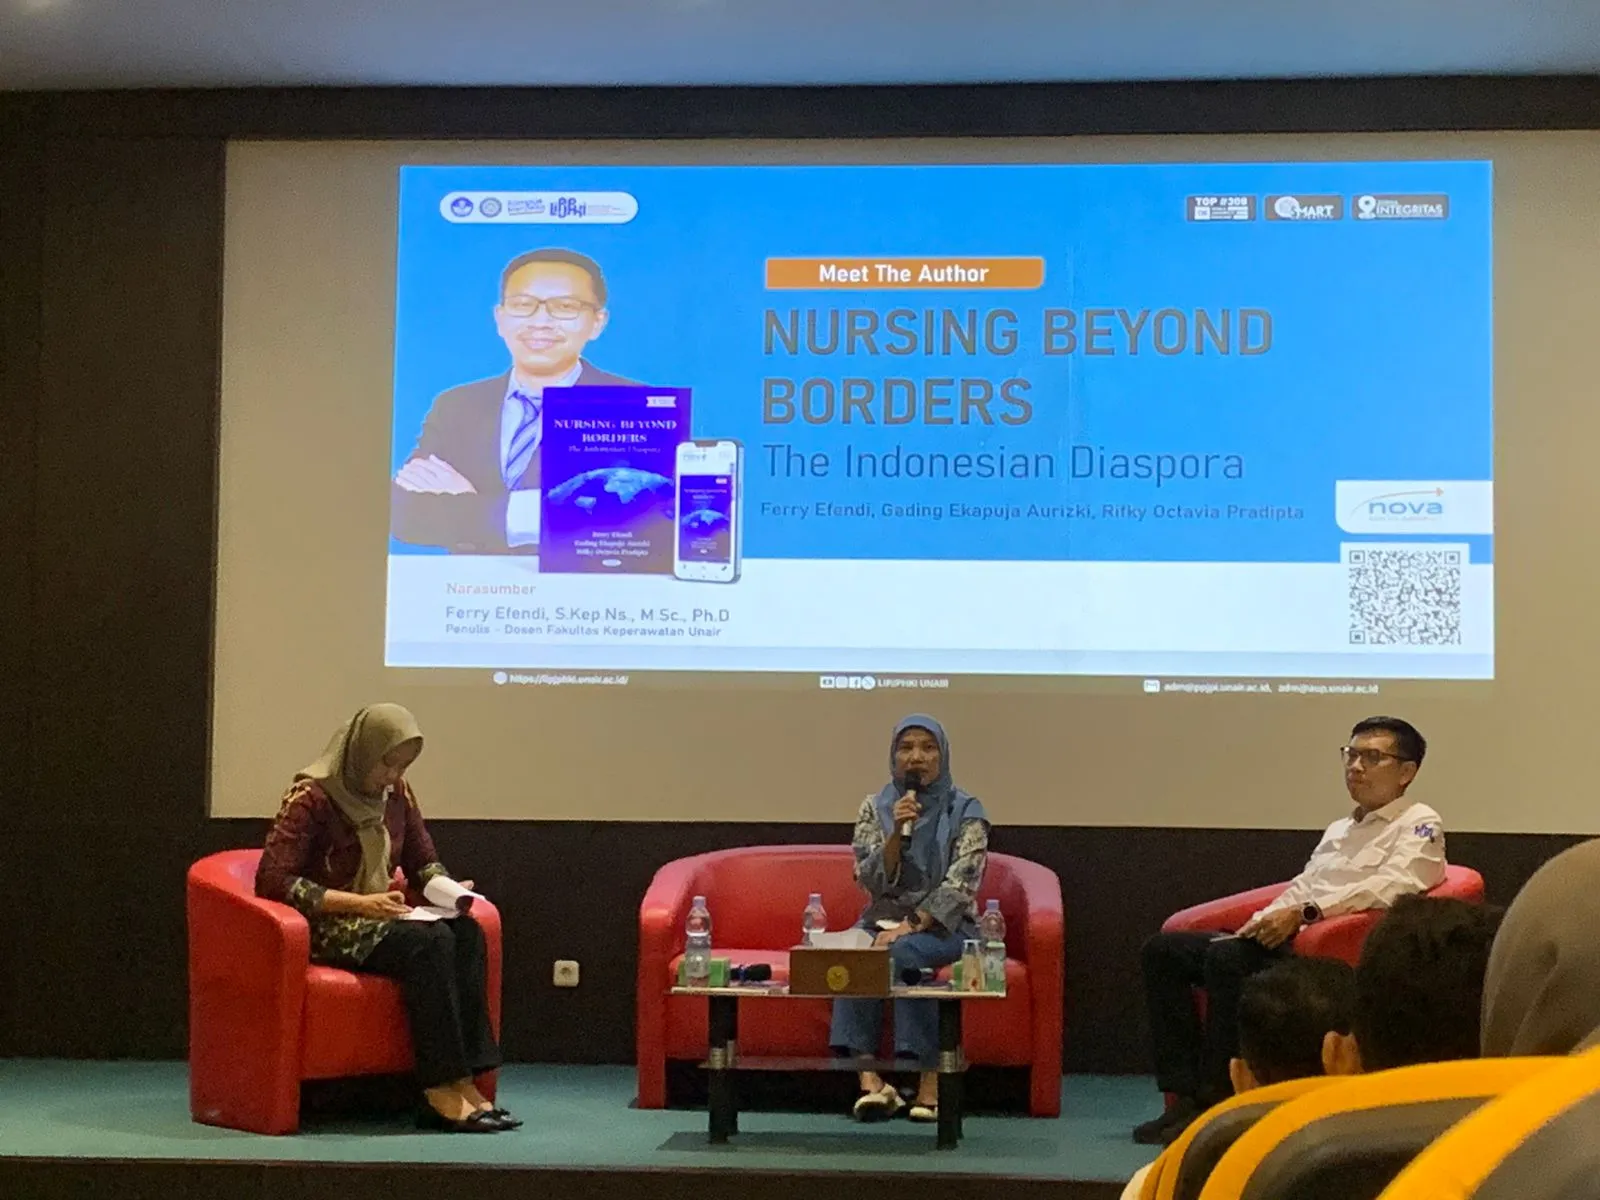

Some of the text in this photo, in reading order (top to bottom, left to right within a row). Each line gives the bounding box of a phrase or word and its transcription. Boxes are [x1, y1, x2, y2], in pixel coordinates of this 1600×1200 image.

[1195, 197, 1218, 206] TOP
[1376, 204, 1443, 215] INTEGRITAS
[819, 263, 989, 283] Meet The Author
[764, 308, 1272, 356] NURSING BEYOND
[762, 377, 1033, 426] BORDERS
[582, 433, 648, 443] BORDERS
[763, 444, 1244, 487] The Indonesian Diaspora
[761, 502, 1304, 522] Ferry Efendi, Gading Ekapuja Aurizki, Rifky Octavia Pradipta
[1369, 501, 1443, 515] nova
[446, 583, 536, 595] Narasumber
[446, 606, 490, 622] Ferry
[495, 606, 549, 621] Efendi,
[692, 608, 729, 622] Ph.D
[446, 624, 490, 634] Penulis
[504, 624, 543, 635] Dosen
[547, 624, 599, 635] Fakultas
[603, 625, 685, 637] Keperawatan
[688, 626, 721, 637] Unair
